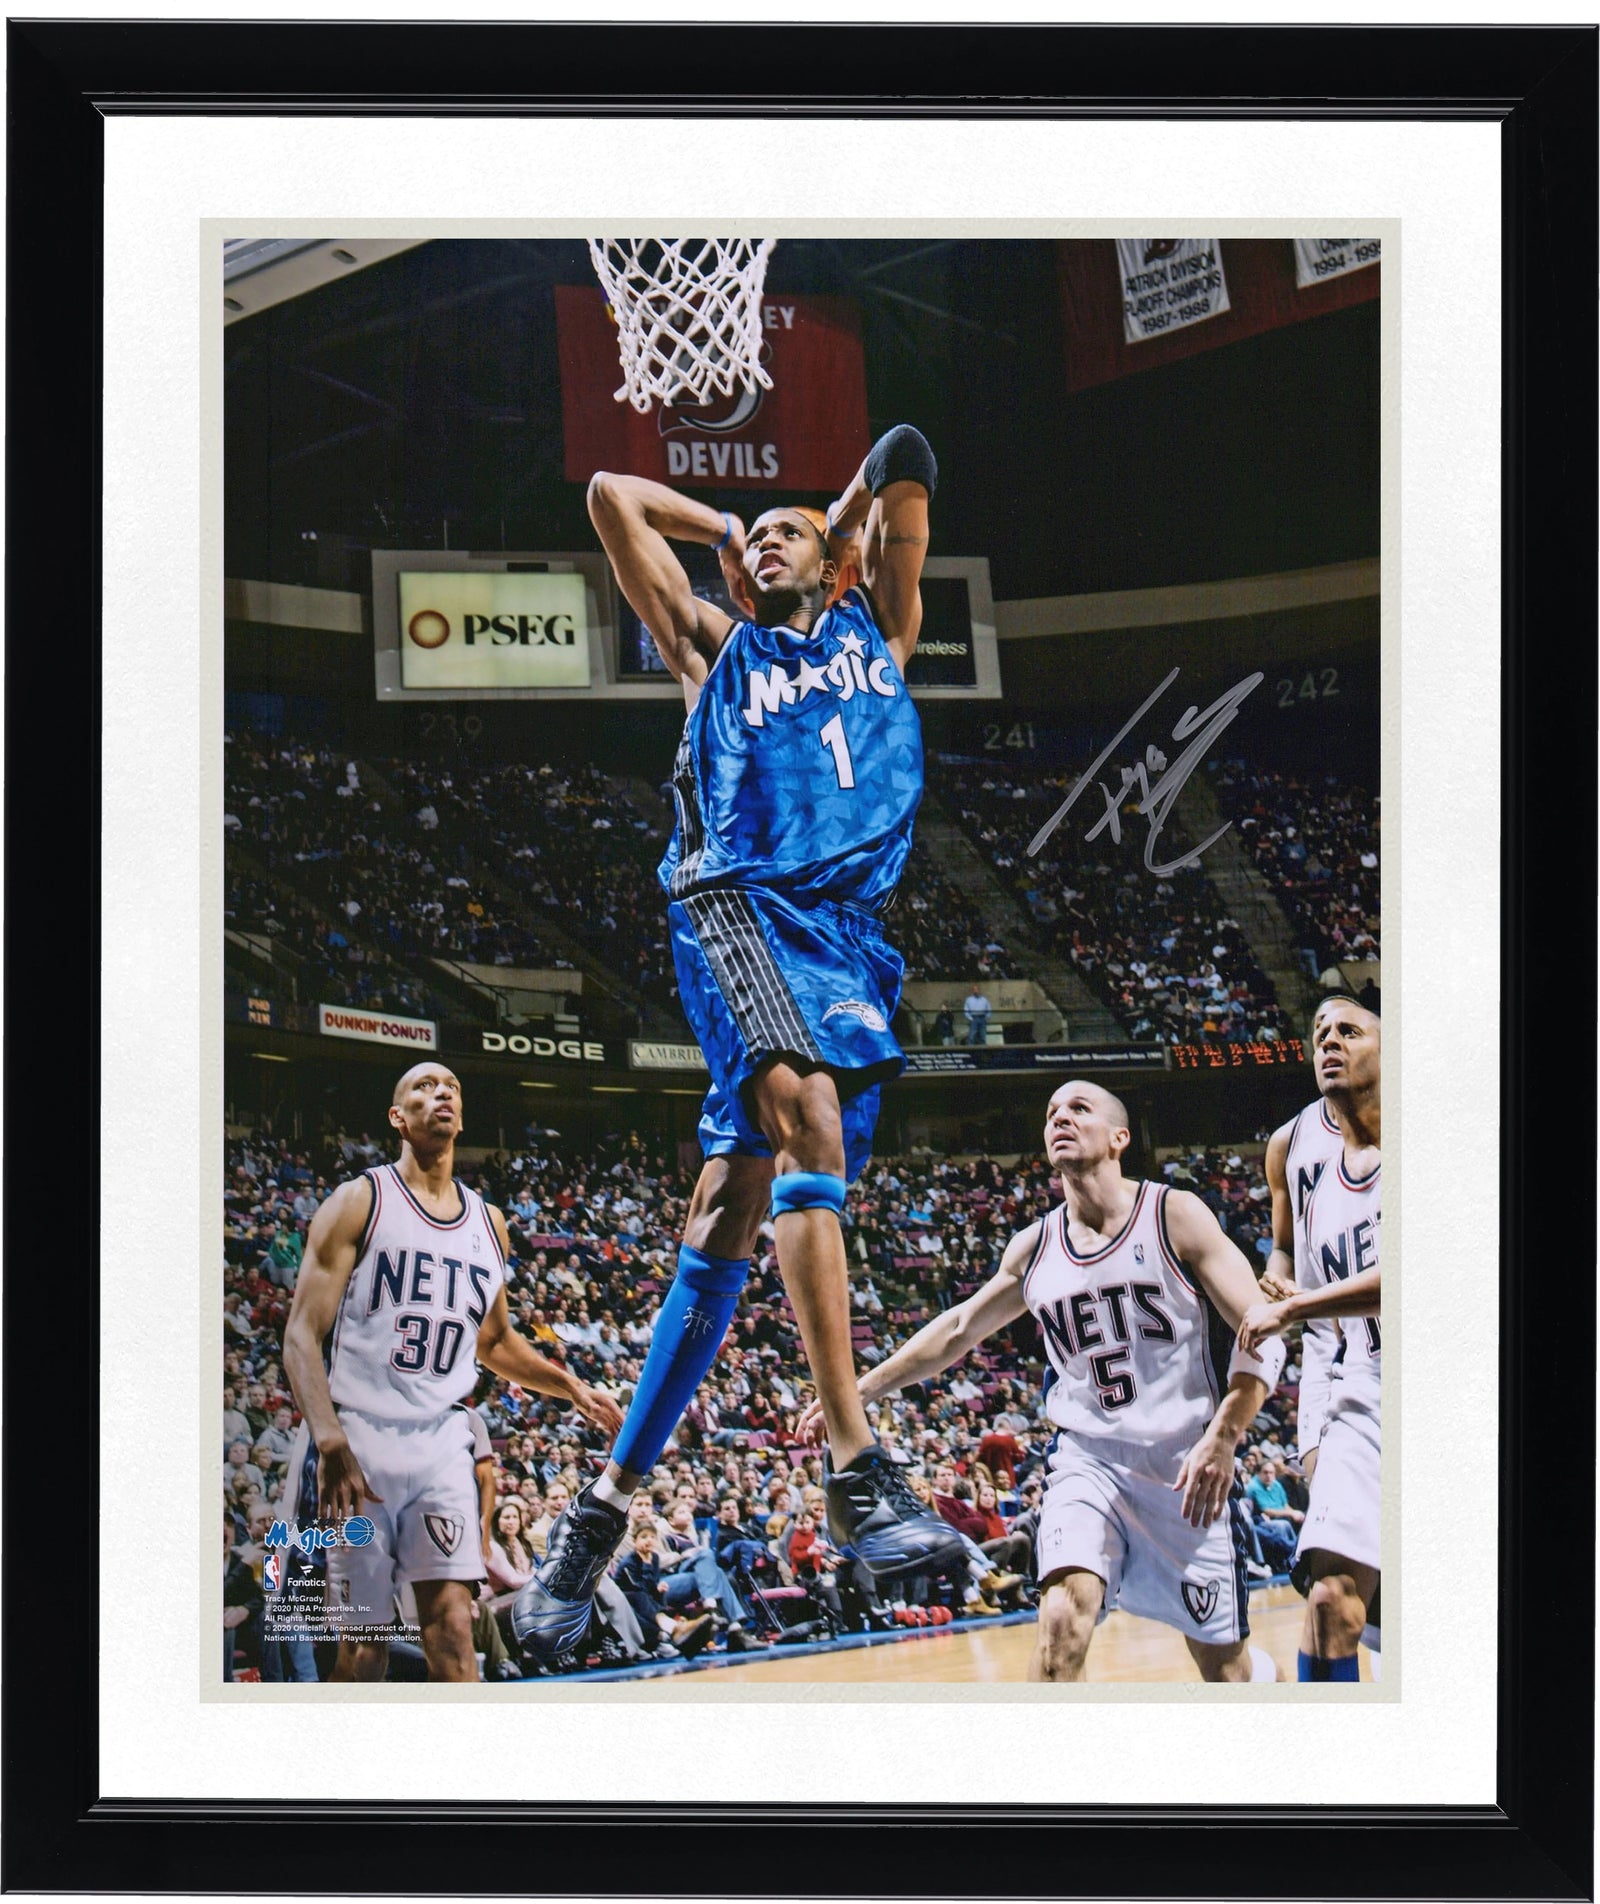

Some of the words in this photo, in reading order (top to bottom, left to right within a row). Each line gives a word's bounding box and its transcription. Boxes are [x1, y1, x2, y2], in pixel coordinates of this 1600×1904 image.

[1170, 248, 1216, 281] DIVISION
[667, 441, 779, 479] DEVILS
[463, 614, 575, 646] PSEG
[915, 639, 969, 656] ireless
[1275, 667, 1341, 708] 242
[819, 712, 856, 789] 1
[982, 721, 1036, 750] 241
[324, 1011, 380, 1034] DUNKIN'
[381, 1022, 432, 1042] DONUTS
[482, 1031, 605, 1062] DODGE
[367, 1247, 492, 1332] NETS
[1038, 1280, 1177, 1368] NETS
[390, 1312, 467, 1377] 30
[1090, 1346, 1138, 1411] 5
